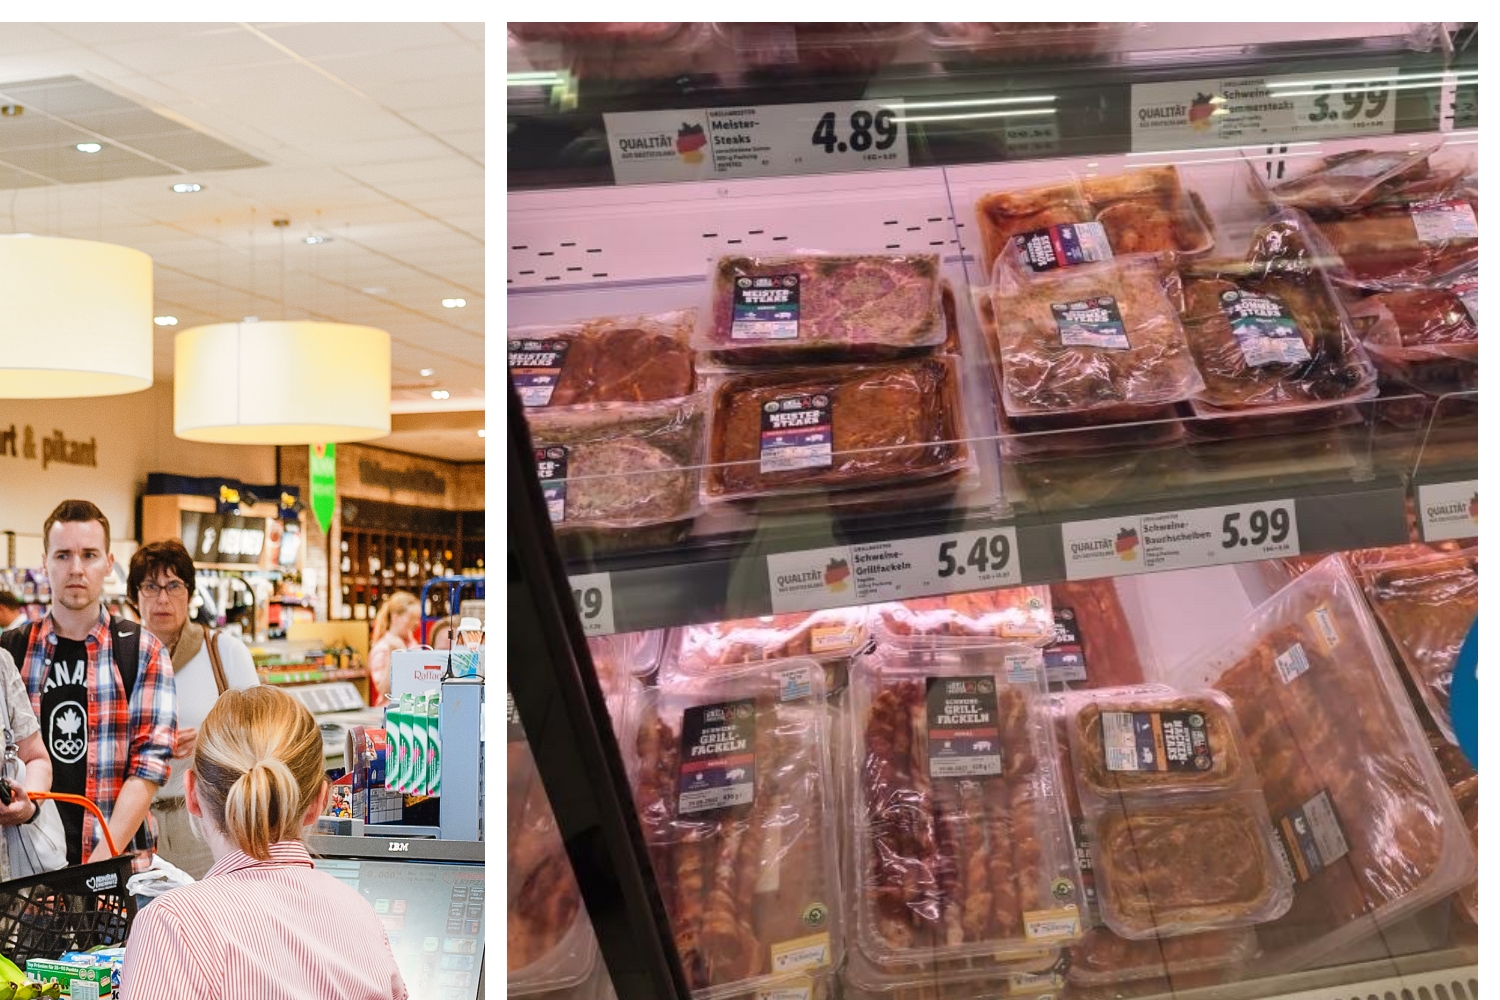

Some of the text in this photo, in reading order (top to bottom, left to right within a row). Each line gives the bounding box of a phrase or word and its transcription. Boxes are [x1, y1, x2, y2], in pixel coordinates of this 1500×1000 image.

[1138, 104, 1187, 121] QUALITÄT
[712, 119, 760, 130] Meister-
[812, 109, 898, 155] 4.89
[619, 136, 673, 151] QUALITÄT
[714, 134, 751, 145] Steaks
[42, 428, 97, 470] pikant
[1427, 502, 1467, 518] QUALITÄT
[1143, 521, 1189, 534] Schweine-
[1221, 507, 1290, 549] 5.99
[1144, 530, 1212, 545] Bauchscheiben
[1070, 538, 1113, 554] QUALITÄT
[854, 551, 904, 563] Schweine-
[938, 534, 1011, 578] 5.49
[855, 561, 912, 576] Grillfackeln
[776, 569, 822, 586] QUALITÄT
[43, 659, 87, 694] ANA
[413, 670, 445, 681] Raffael
[944, 704, 983, 714] GRILL-
[937, 713, 990, 725] FACKELN
[700, 732, 739, 745] GRILL-
[691, 740, 747, 756] FACKELN
[388, 841, 409, 852] IBM
